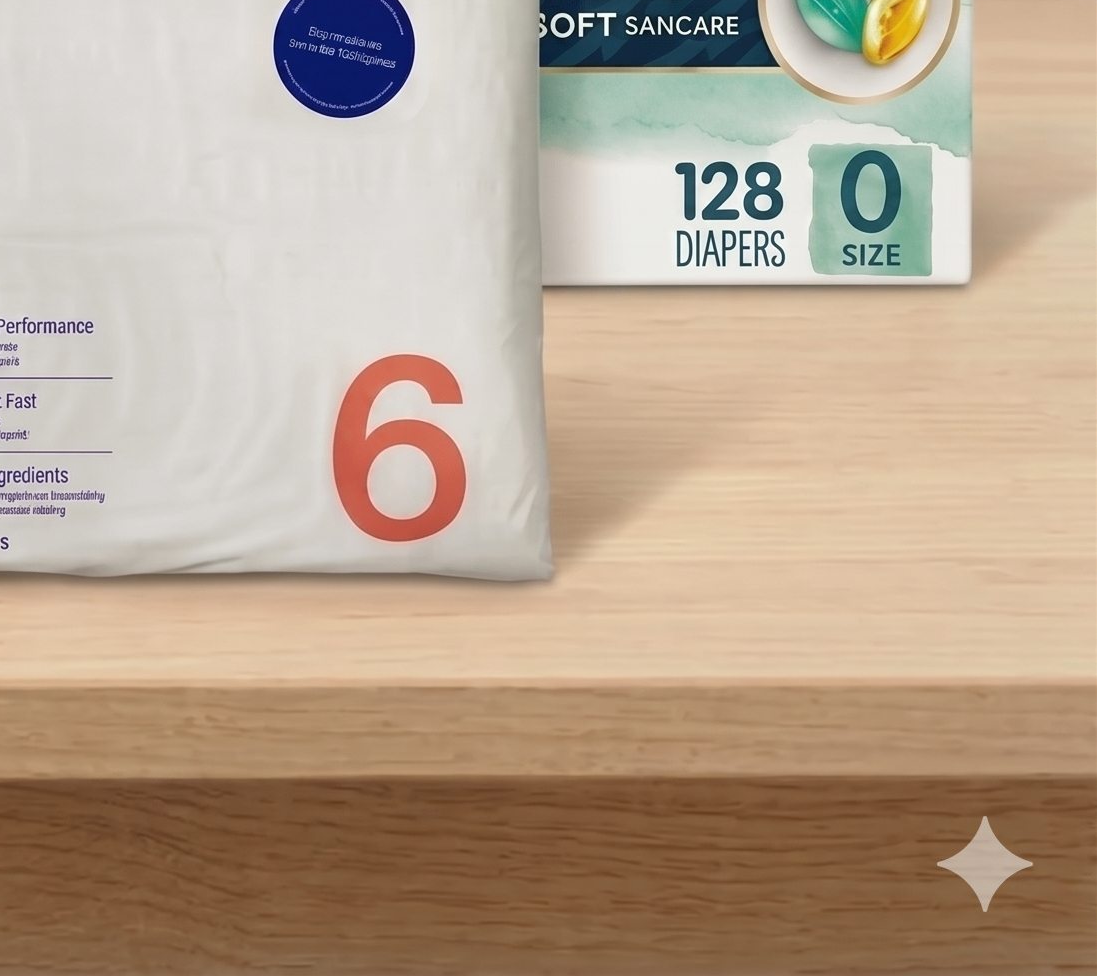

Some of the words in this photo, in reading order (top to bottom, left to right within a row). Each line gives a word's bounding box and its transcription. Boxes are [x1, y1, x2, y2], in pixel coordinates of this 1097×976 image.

[625, 15, 740, 36] SANCARE
[674, 161, 785, 221] 128
[839, 149, 902, 234] 0
[675, 229, 787, 268] DIAPERS
[841, 243, 902, 267] SIZE
[6, 393, 38, 410] Fast
[332, 354, 467, 542] 6
